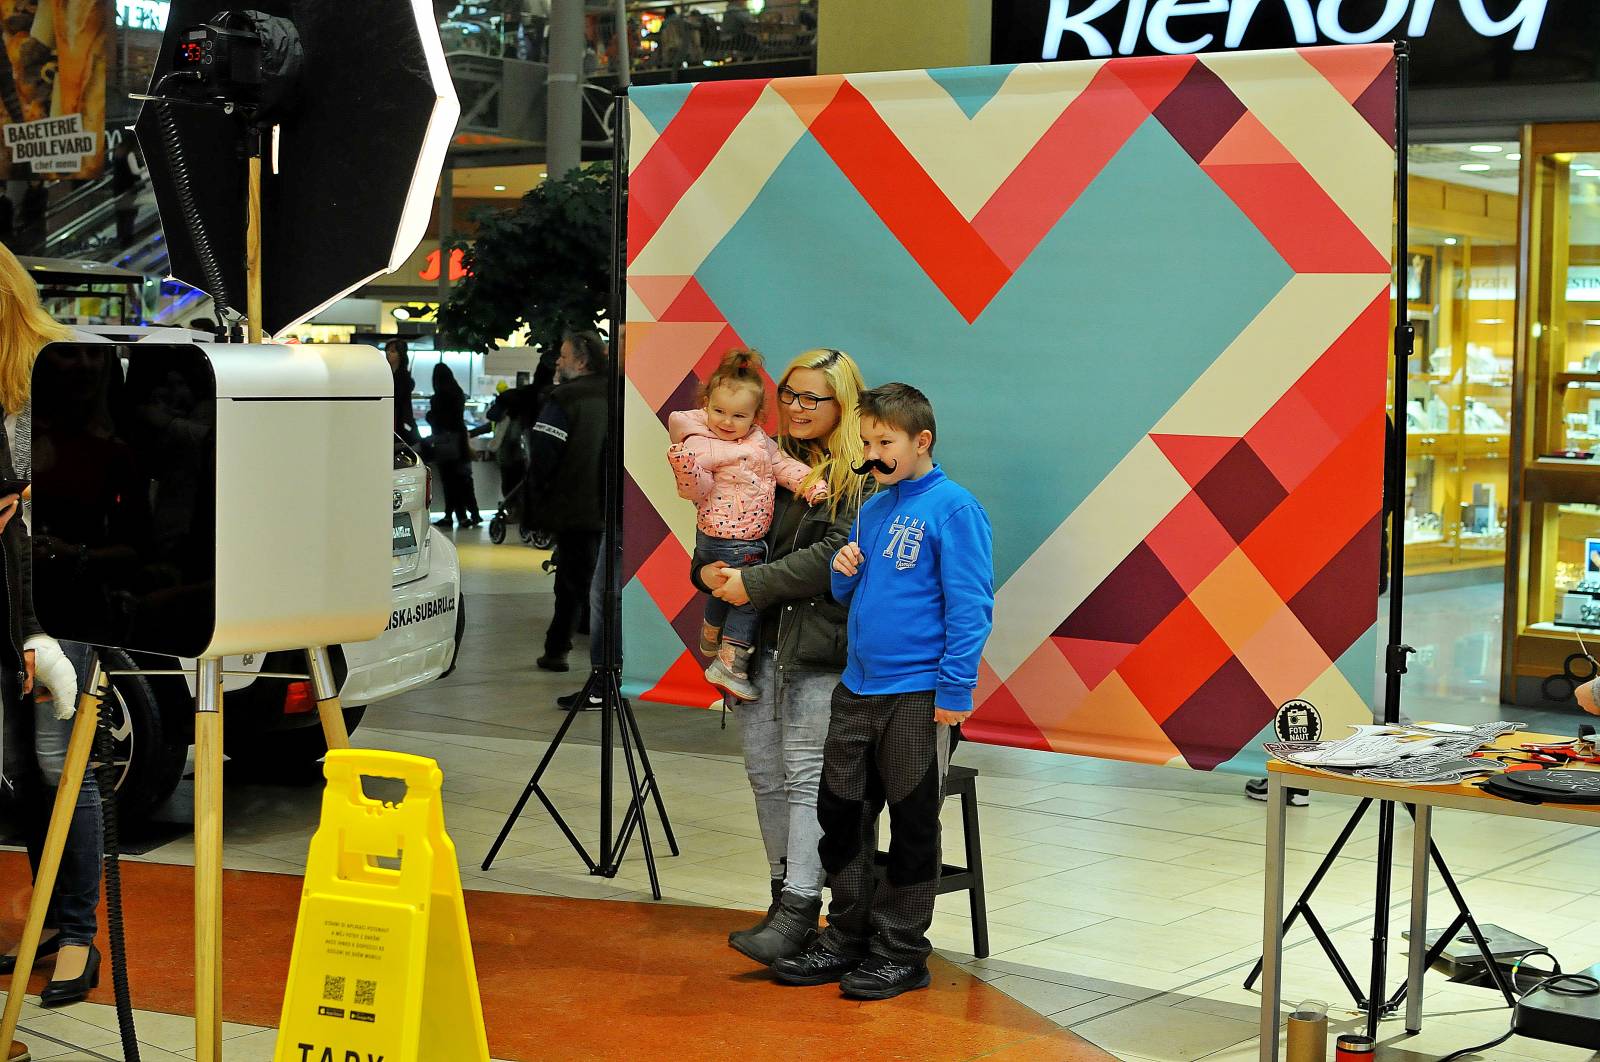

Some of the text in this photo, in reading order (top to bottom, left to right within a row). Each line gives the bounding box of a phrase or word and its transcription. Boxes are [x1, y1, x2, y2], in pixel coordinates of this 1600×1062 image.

[7, 117, 79, 143] BAGETERIE
[16, 136, 93, 159] BOULEVARD
[882, 523, 924, 563] 76
[384, 597, 456, 632] ISKA-SUBARU.cz
[1289, 726, 1308, 735] FOTO
[1289, 733, 1310, 741] NAUT
